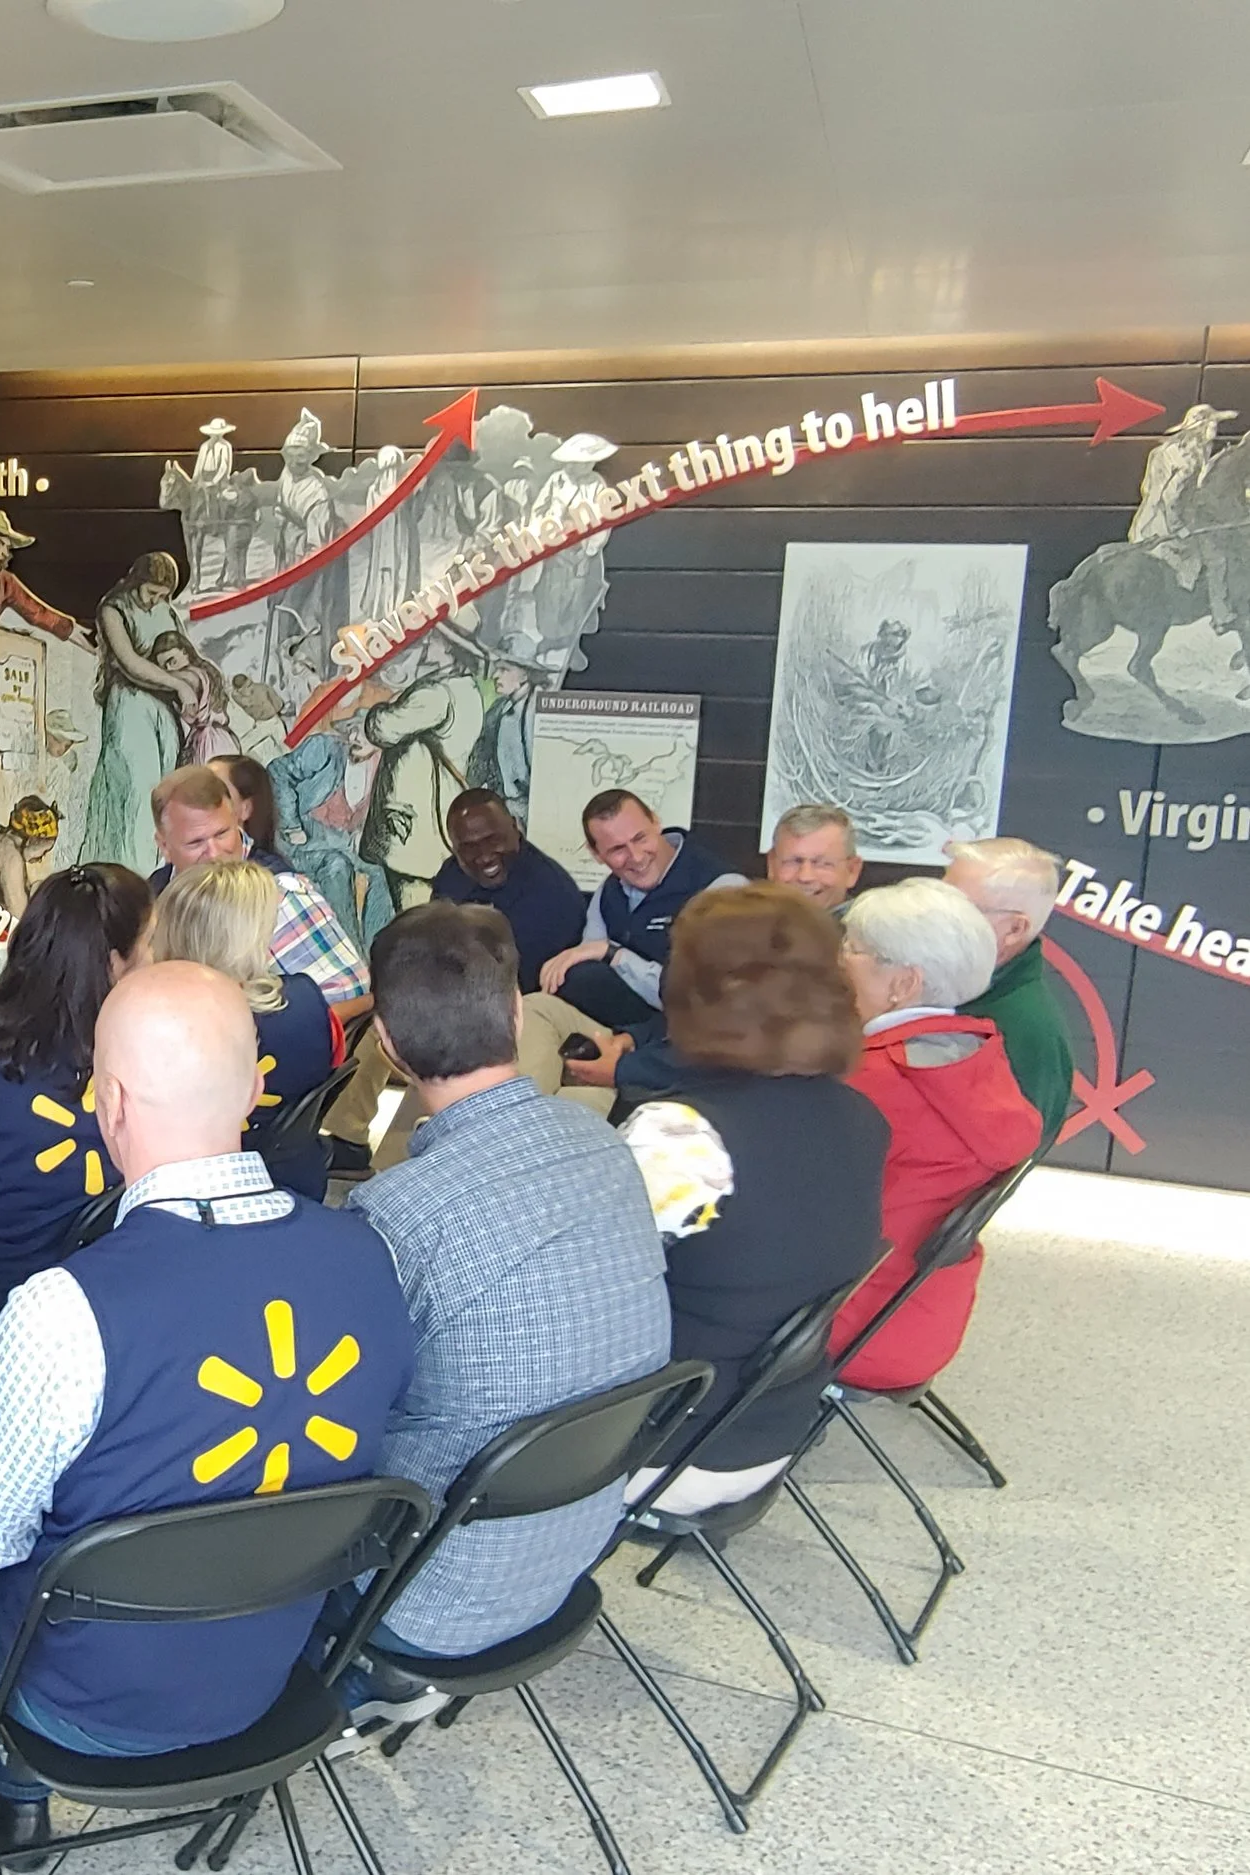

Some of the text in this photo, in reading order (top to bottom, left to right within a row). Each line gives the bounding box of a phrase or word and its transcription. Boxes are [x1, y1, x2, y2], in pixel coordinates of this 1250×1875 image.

[330, 378, 957, 682] Slavery is the next thing to hell
[541, 697, 694, 714] UNDERGROUND RAILROAD
[1055, 859, 1163, 941] Take
